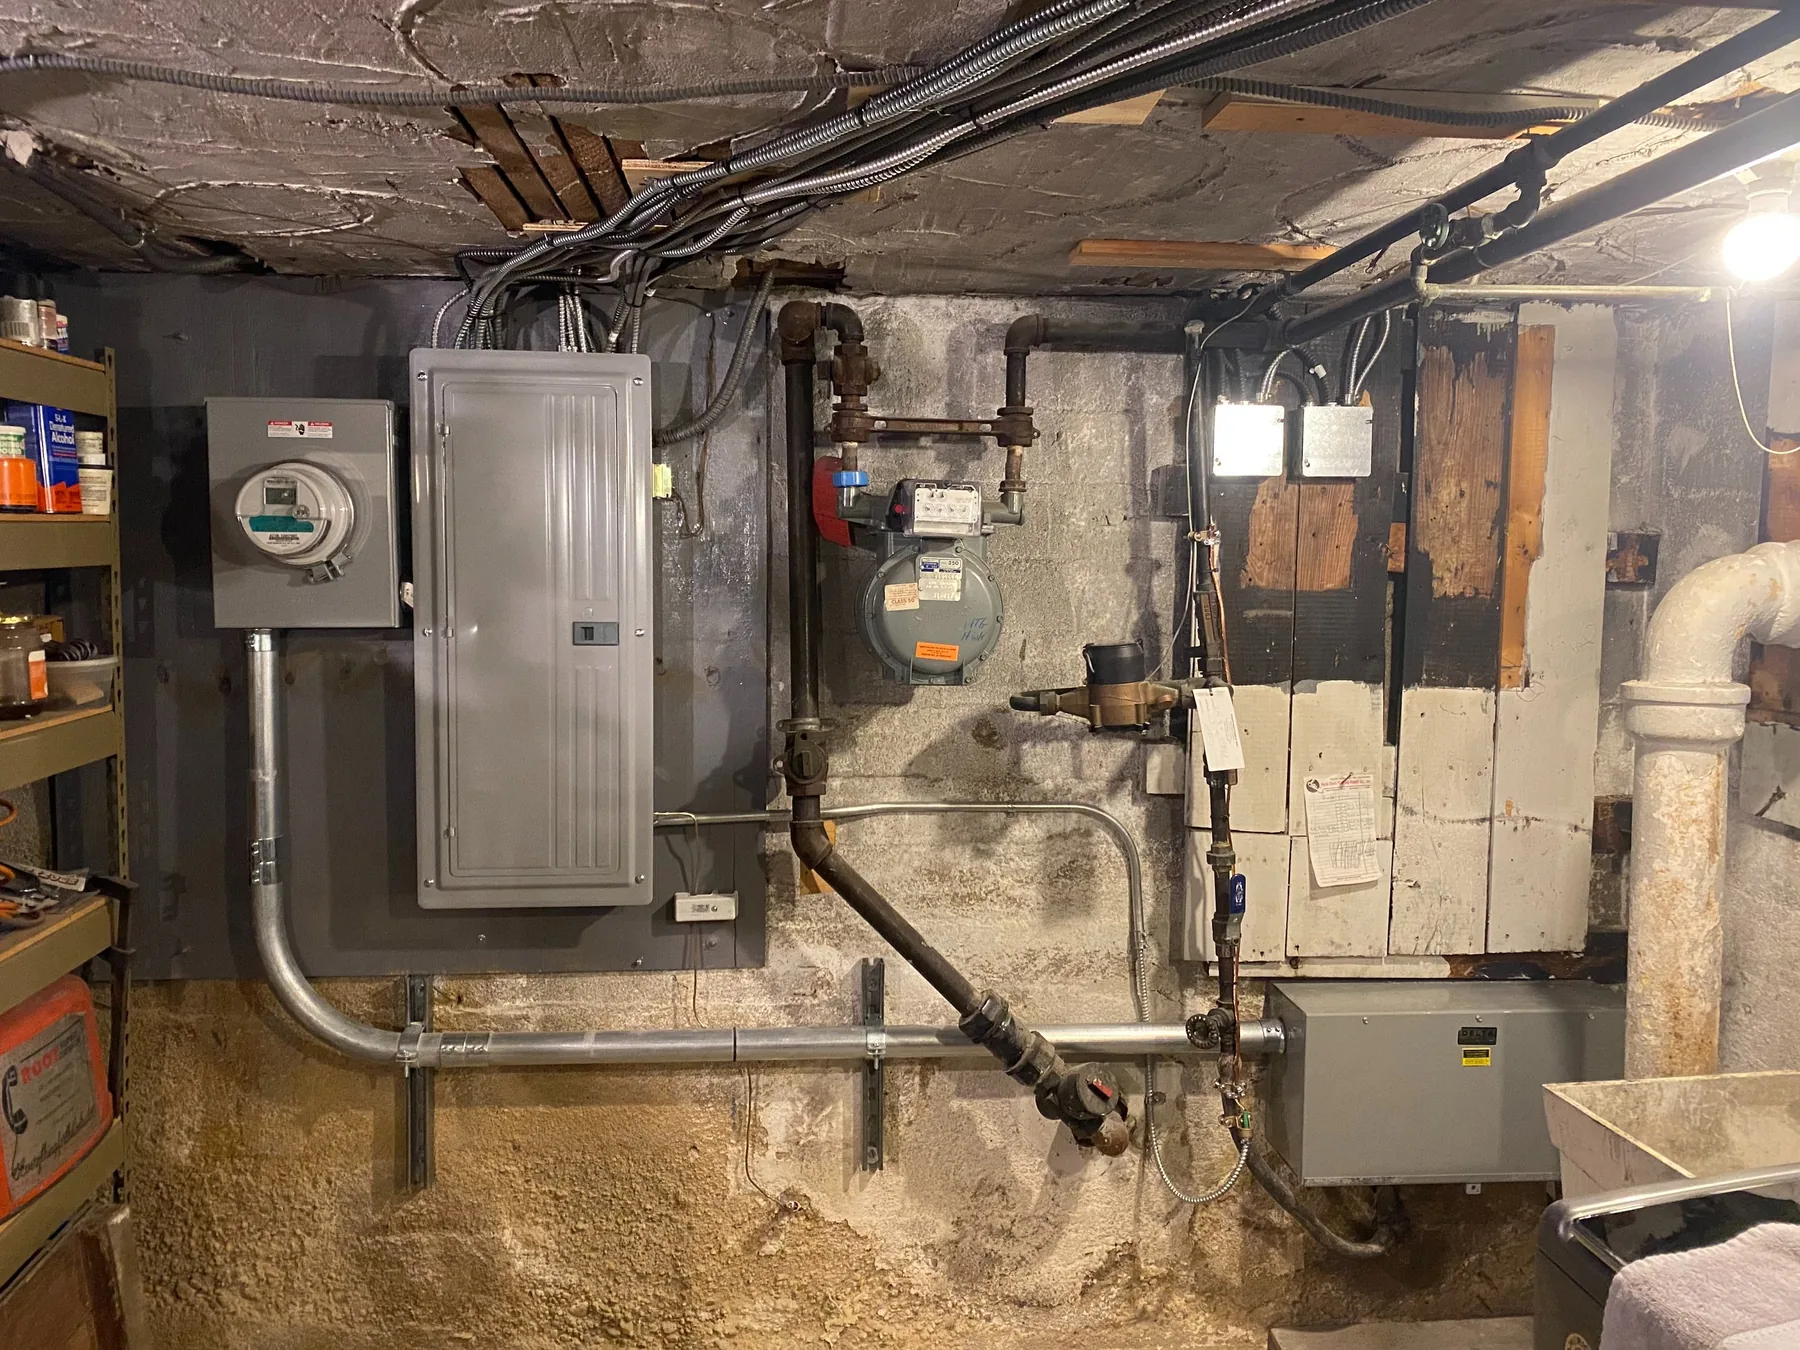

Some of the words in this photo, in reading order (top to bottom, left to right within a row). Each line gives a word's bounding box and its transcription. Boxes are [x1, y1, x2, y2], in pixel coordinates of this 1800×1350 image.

[52, 431, 75, 444] Alcohol
[891, 598, 907, 606] CLASS
[1462, 1029, 1494, 1037] DELTA
